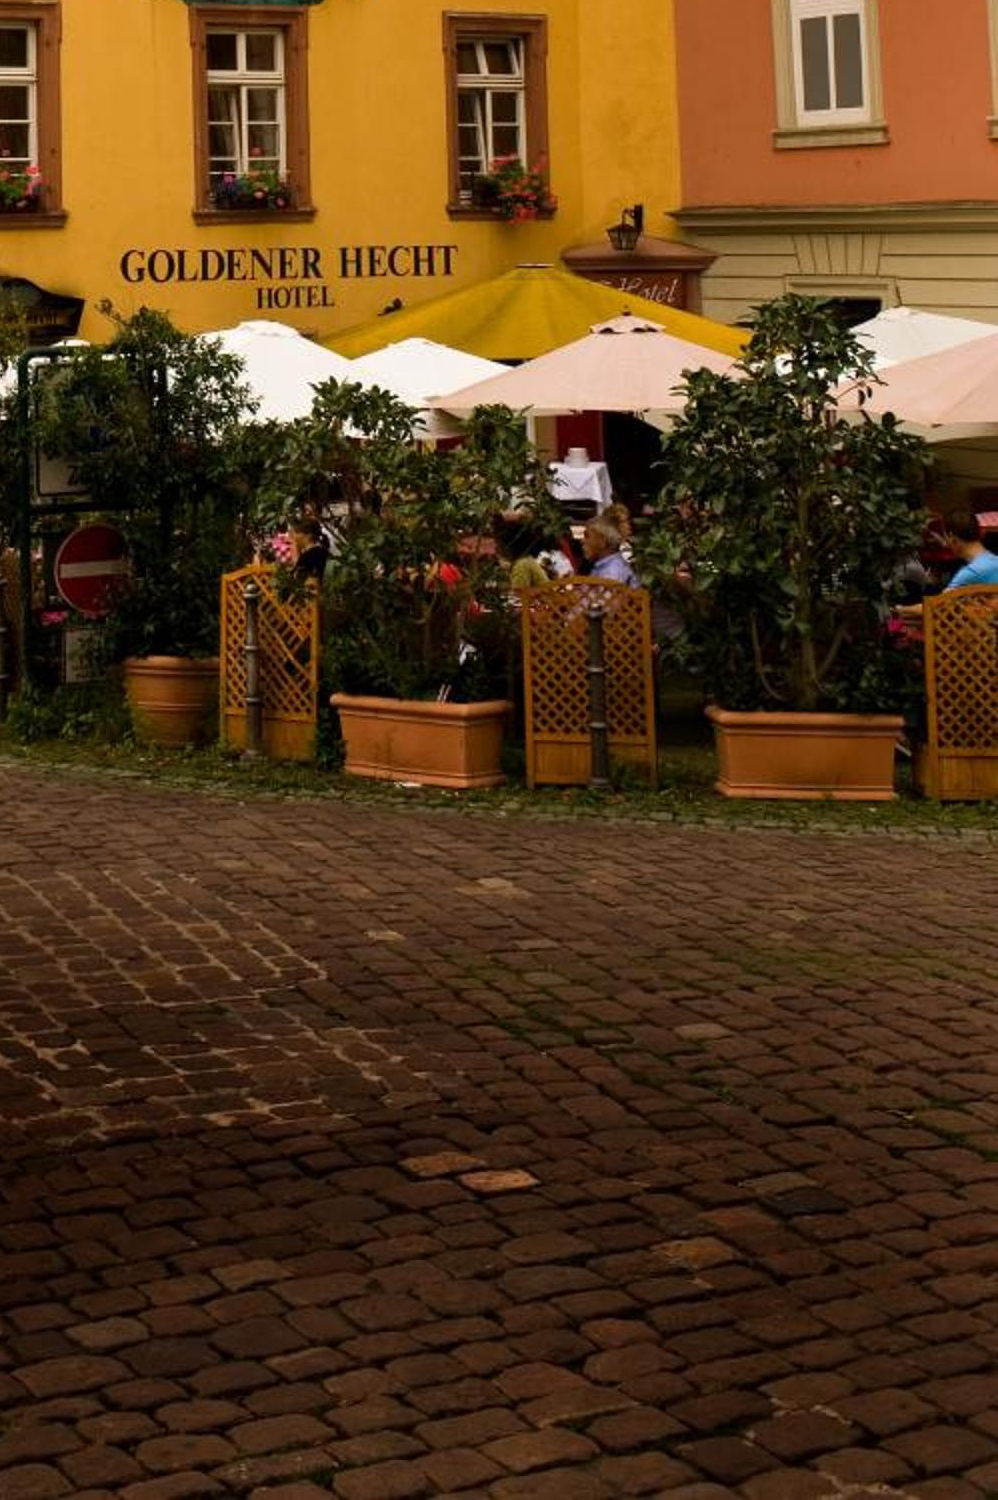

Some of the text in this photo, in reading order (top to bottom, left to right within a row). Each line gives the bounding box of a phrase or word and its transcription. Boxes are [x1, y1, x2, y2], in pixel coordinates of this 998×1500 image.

[120, 245, 458, 283] GOLDENER HECHT
[256, 285, 336, 310] HOTEL
